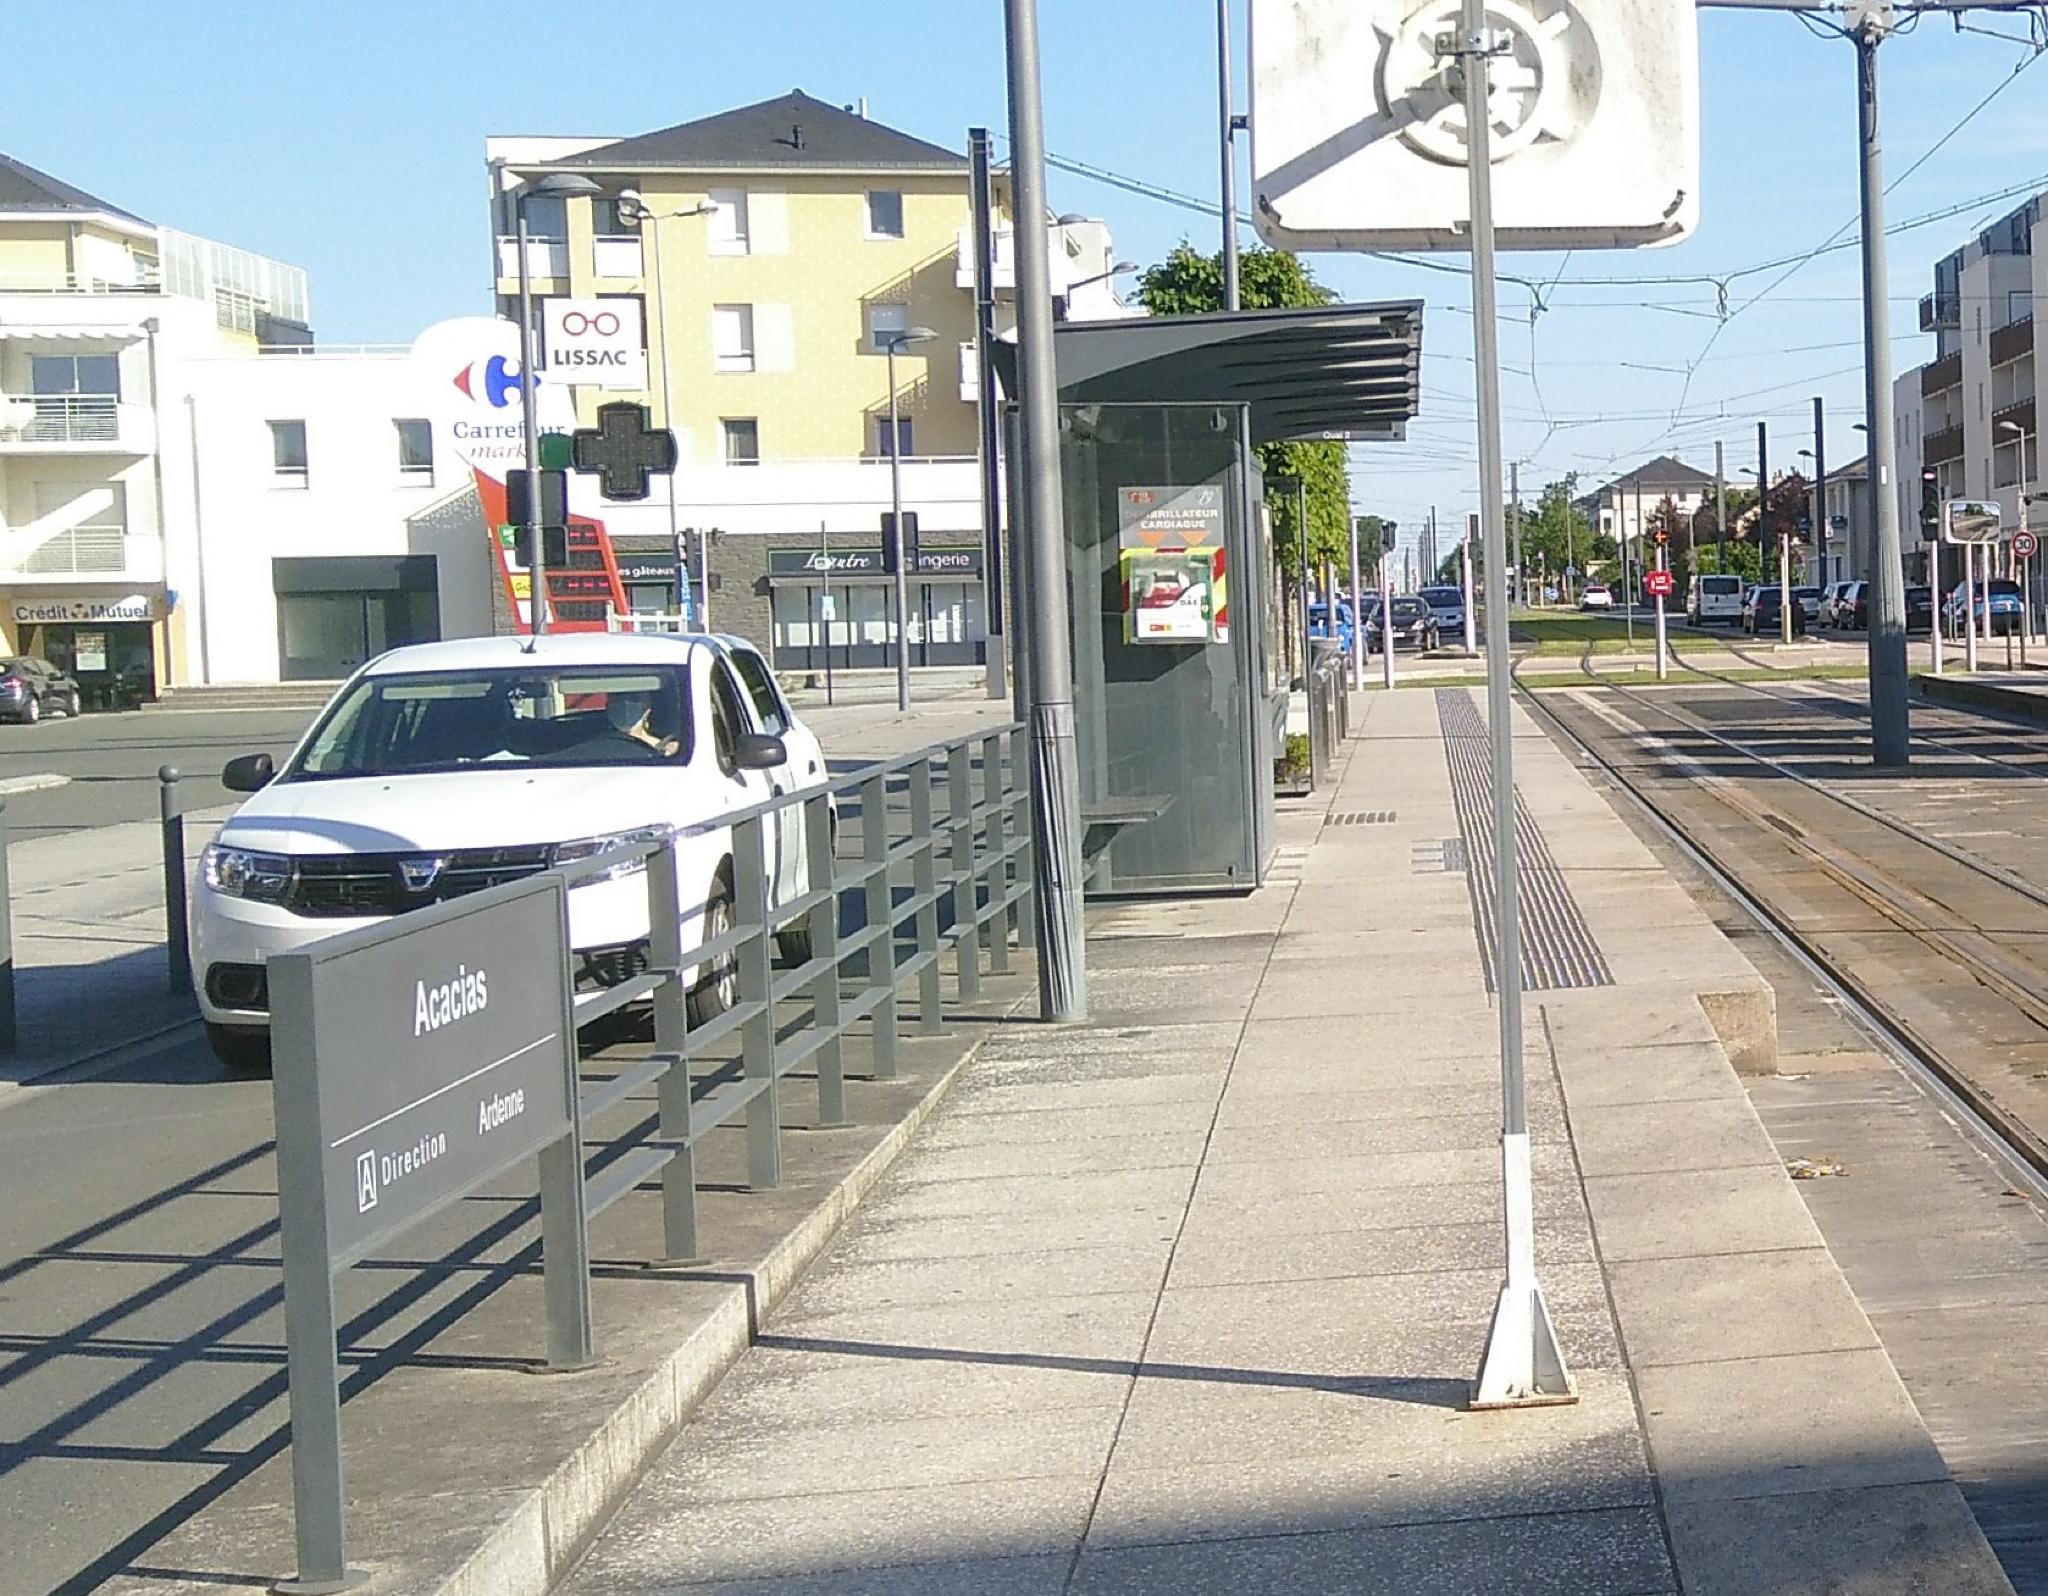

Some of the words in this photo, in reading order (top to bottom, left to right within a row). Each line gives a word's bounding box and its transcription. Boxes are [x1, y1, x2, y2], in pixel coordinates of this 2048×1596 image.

[554, 350, 626, 365] LISSAC
[453, 421, 565, 438] Carrefur
[2016, 538, 2031, 550] 30
[617, 567, 631, 576] es
[16, 604, 68, 621] Crédit
[90, 603, 149, 618] Mutuel
[415, 964, 488, 1037] Acacias
[360, 1156, 377, 1207] A
[382, 1131, 447, 1187] Direction
[478, 1087, 525, 1135] Ardenne
